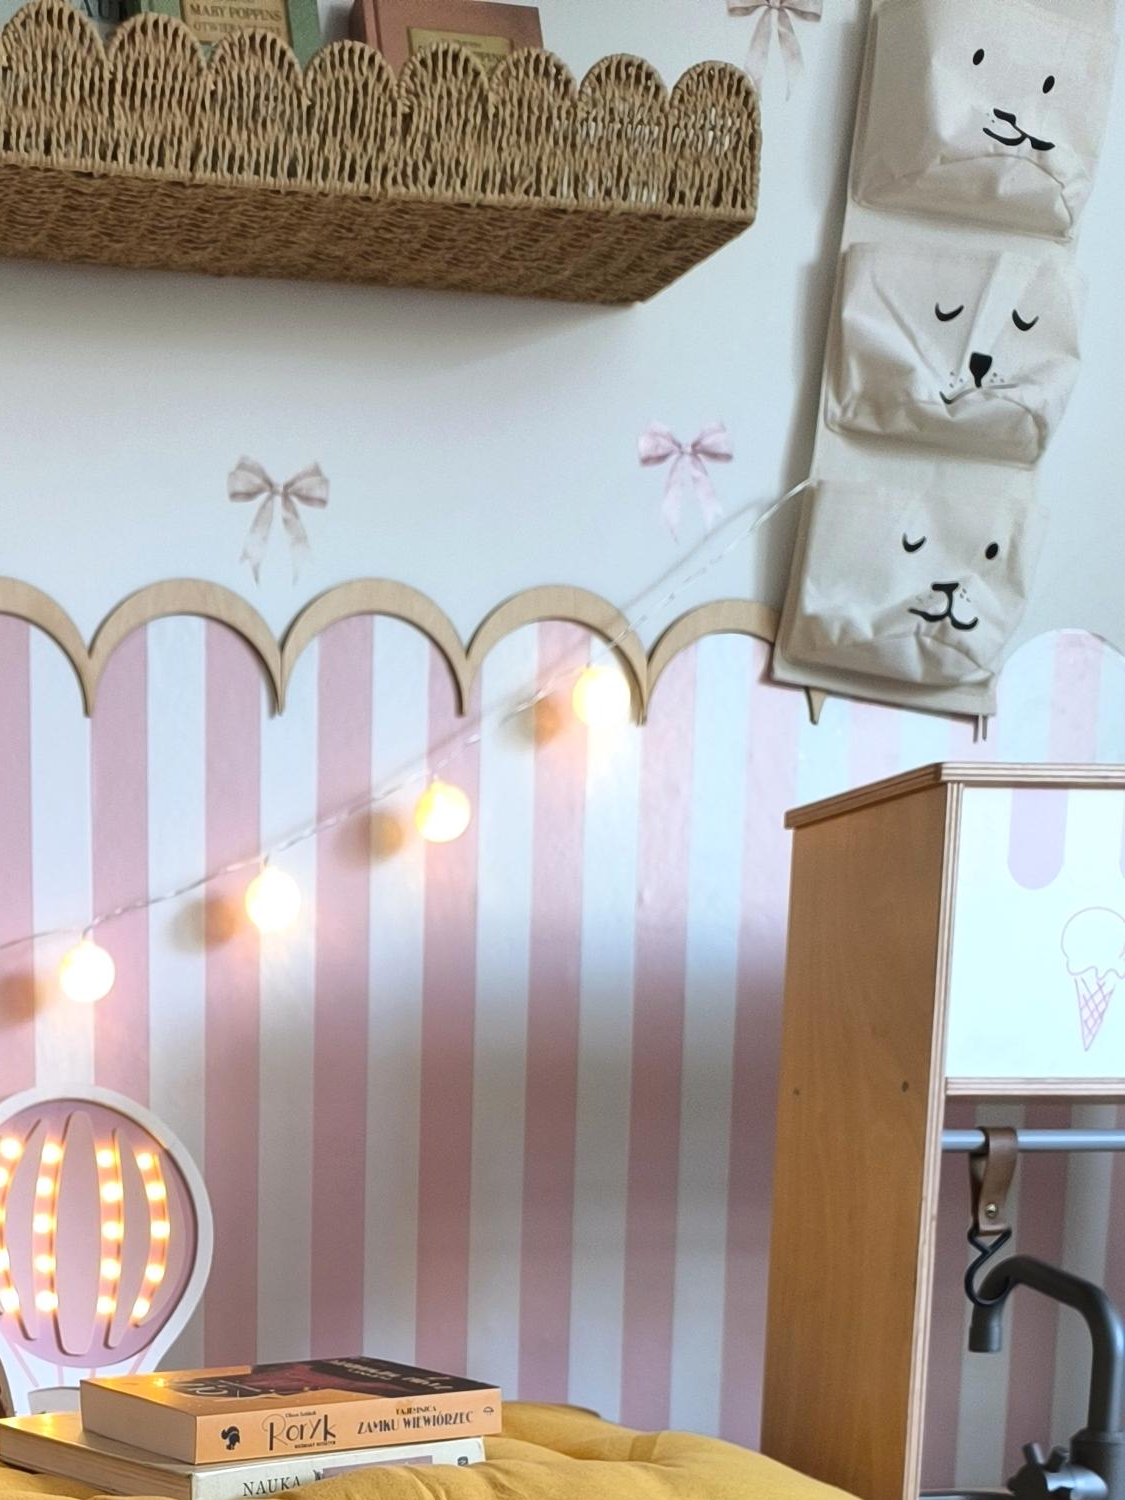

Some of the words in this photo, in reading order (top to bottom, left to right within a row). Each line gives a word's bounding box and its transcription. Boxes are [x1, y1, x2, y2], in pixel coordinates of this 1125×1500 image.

[190, 4, 225, 17] MARY
[261, 1413, 337, 1451] Roryk
[357, 1419, 400, 1434] ZAMKU
[403, 1411, 474, 1429] WIEWIÓRZEC
[243, 1475, 300, 1497] NAUKA
